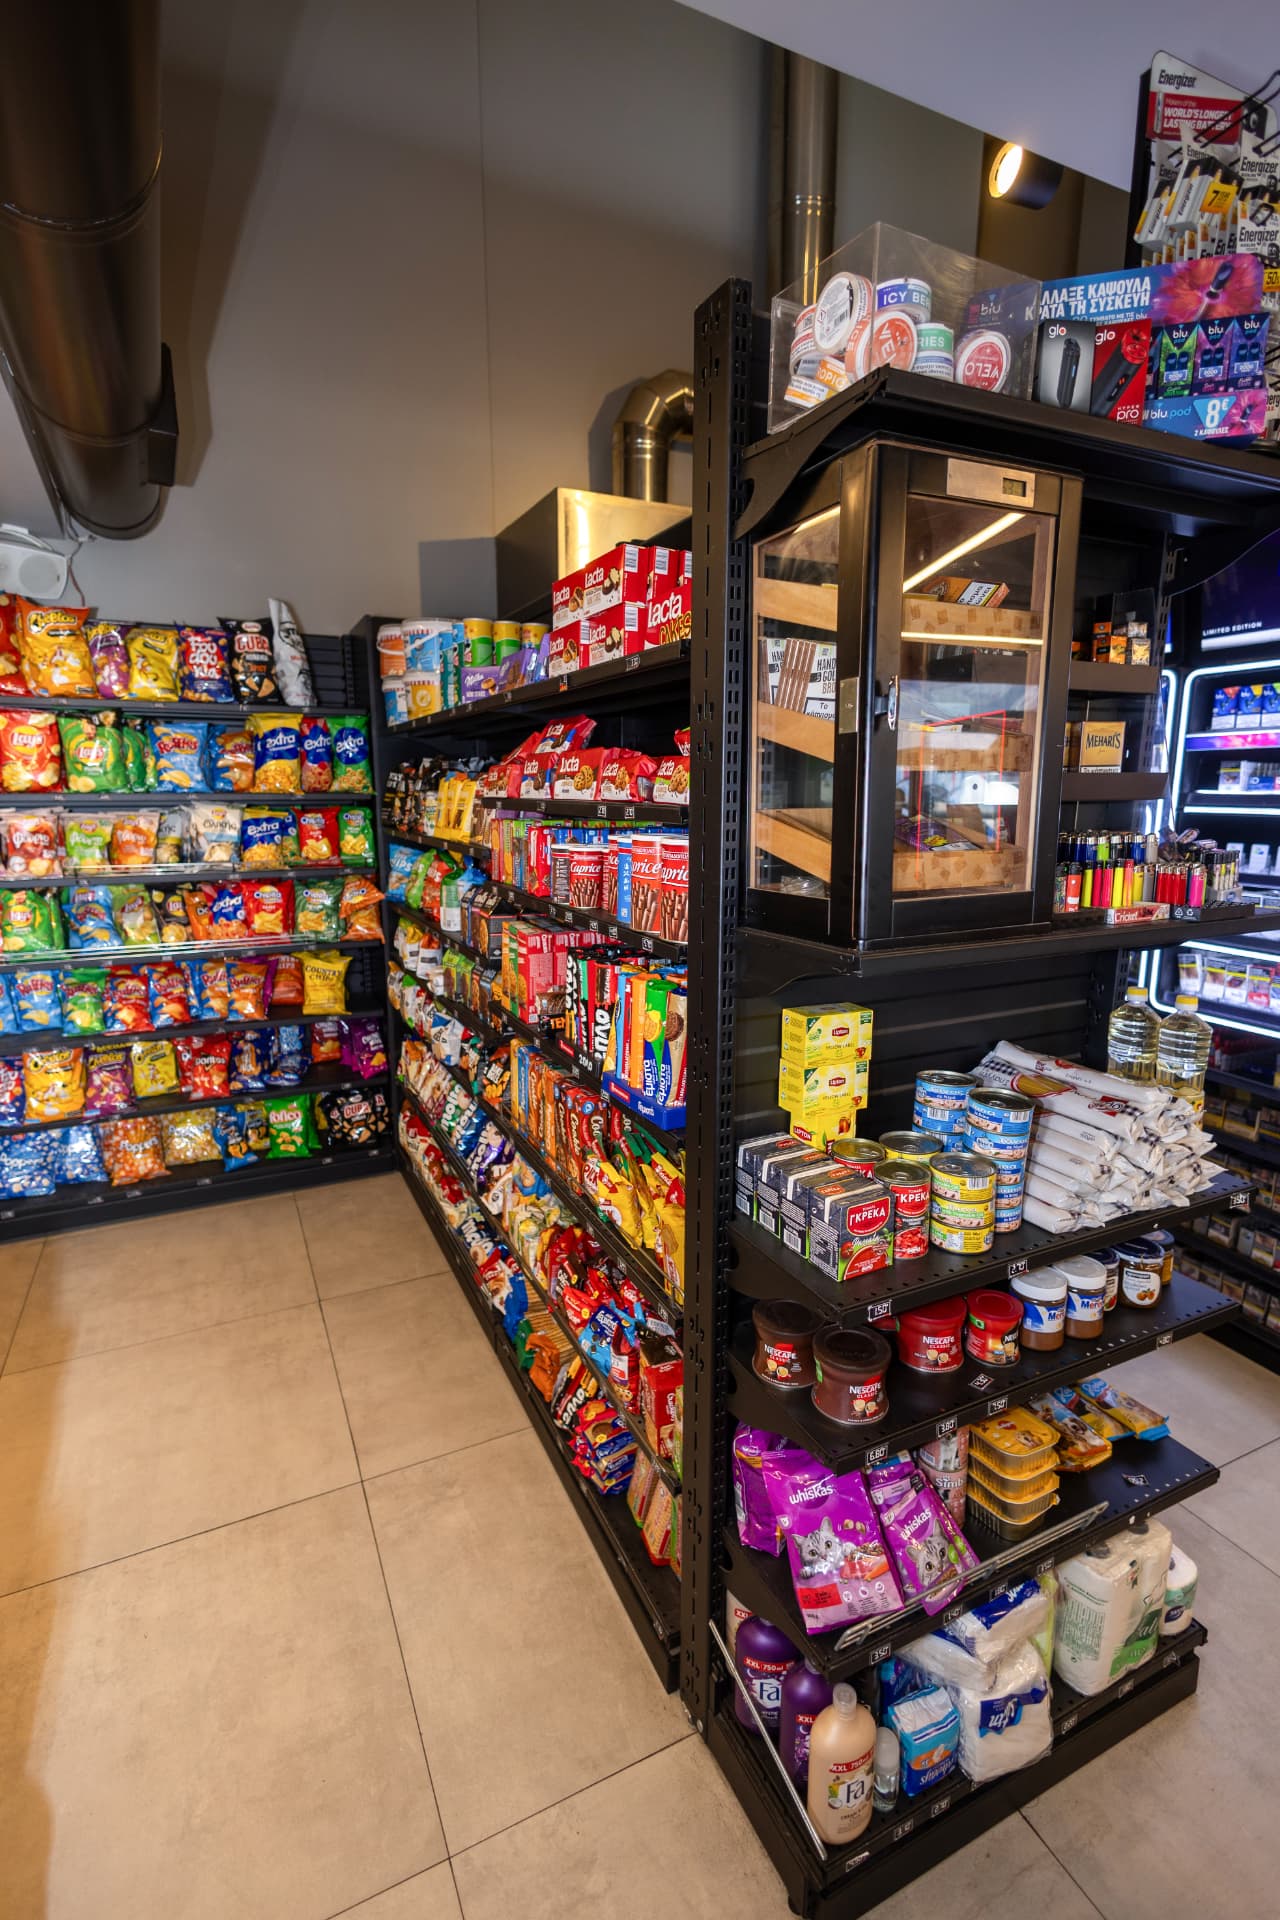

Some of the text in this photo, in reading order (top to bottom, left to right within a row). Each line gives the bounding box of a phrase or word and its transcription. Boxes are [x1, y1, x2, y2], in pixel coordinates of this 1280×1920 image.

[1157, 69, 1197, 89] Energizer
[1240, 156, 1279, 177] Energizer
[1239, 226, 1279, 246] Energizer
[883, 292, 907, 306] ICY
[1049, 324, 1067, 338] glo
[1208, 325, 1224, 335] blu
[1244, 320, 1260, 330] blu
[1095, 329, 1116, 345] glo
[1172, 329, 1188, 339] blu
[1116, 409, 1139, 423] pro
[1150, 406, 1168, 419] blu
[1202, 621, 1262, 637] LIMITED EDITION
[570, 862, 600, 875] Caprice
[1114, 910, 1139, 922] Cricket
[789, 1482, 834, 1504] whiskas
[901, 1509, 932, 1540] whiskas
[745, 1658, 760, 1670] XXL
[759, 1682, 780, 1701] Fa
[846, 1778, 864, 1804] Fa
